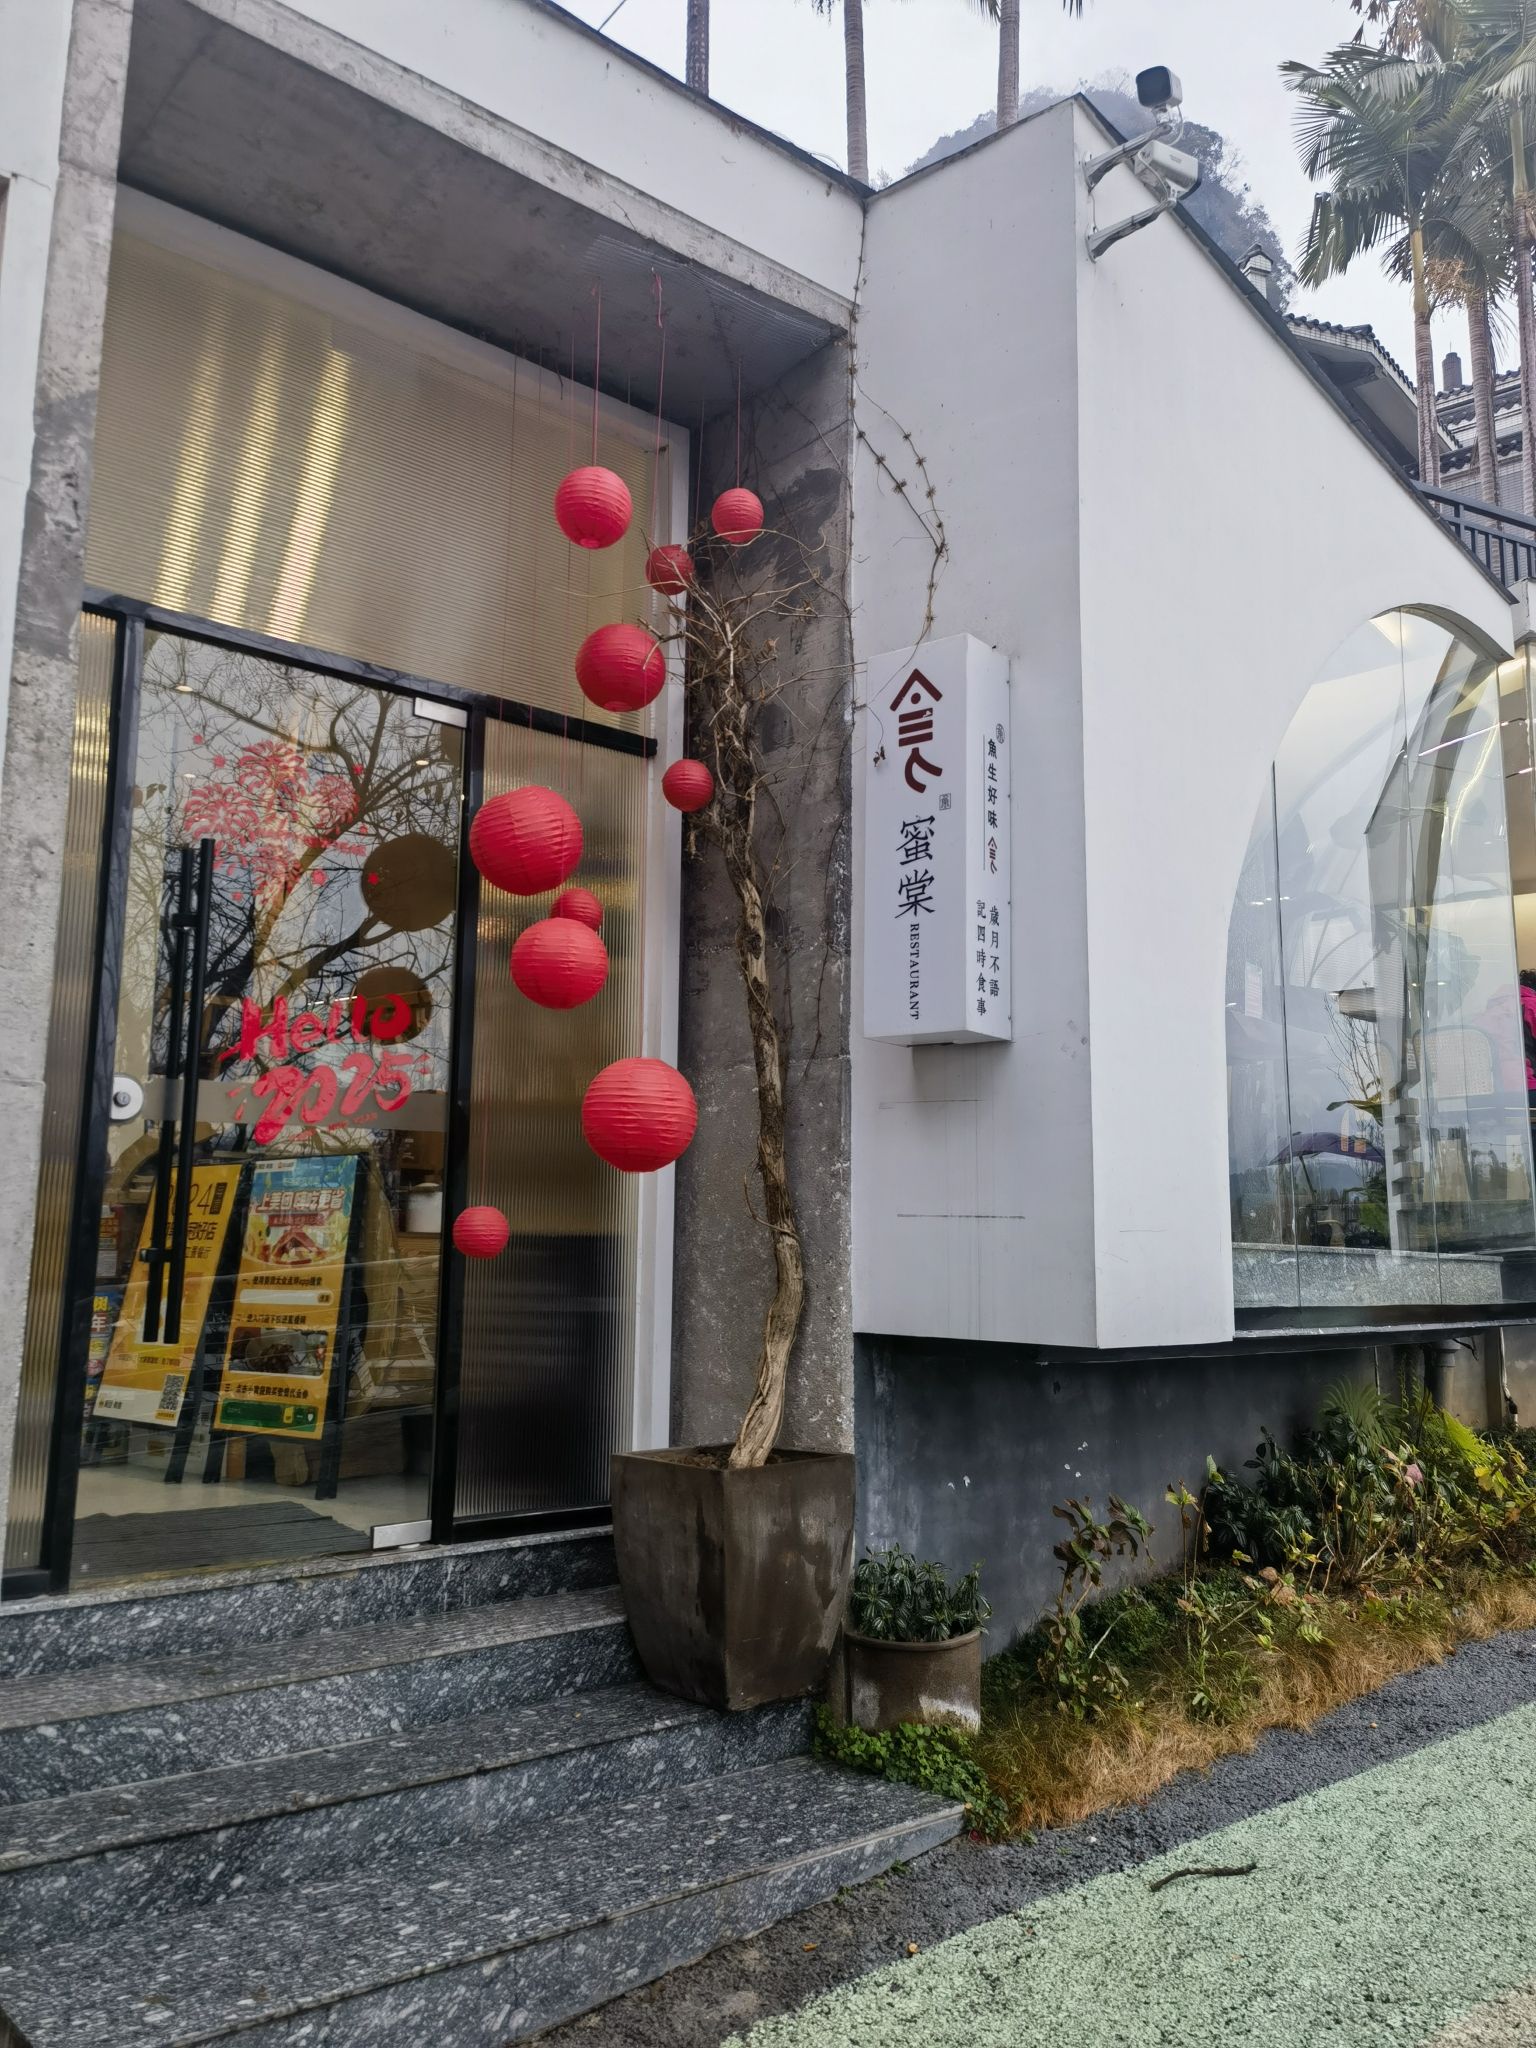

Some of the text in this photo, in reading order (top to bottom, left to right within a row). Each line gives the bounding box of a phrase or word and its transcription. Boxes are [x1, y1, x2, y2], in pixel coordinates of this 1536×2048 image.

[895, 814, 935, 918] 蜜棠
[909, 923, 920, 1020] RESTAURANT
[218, 994, 411, 1061] Hello
[253, 1053, 413, 1145] 2025
